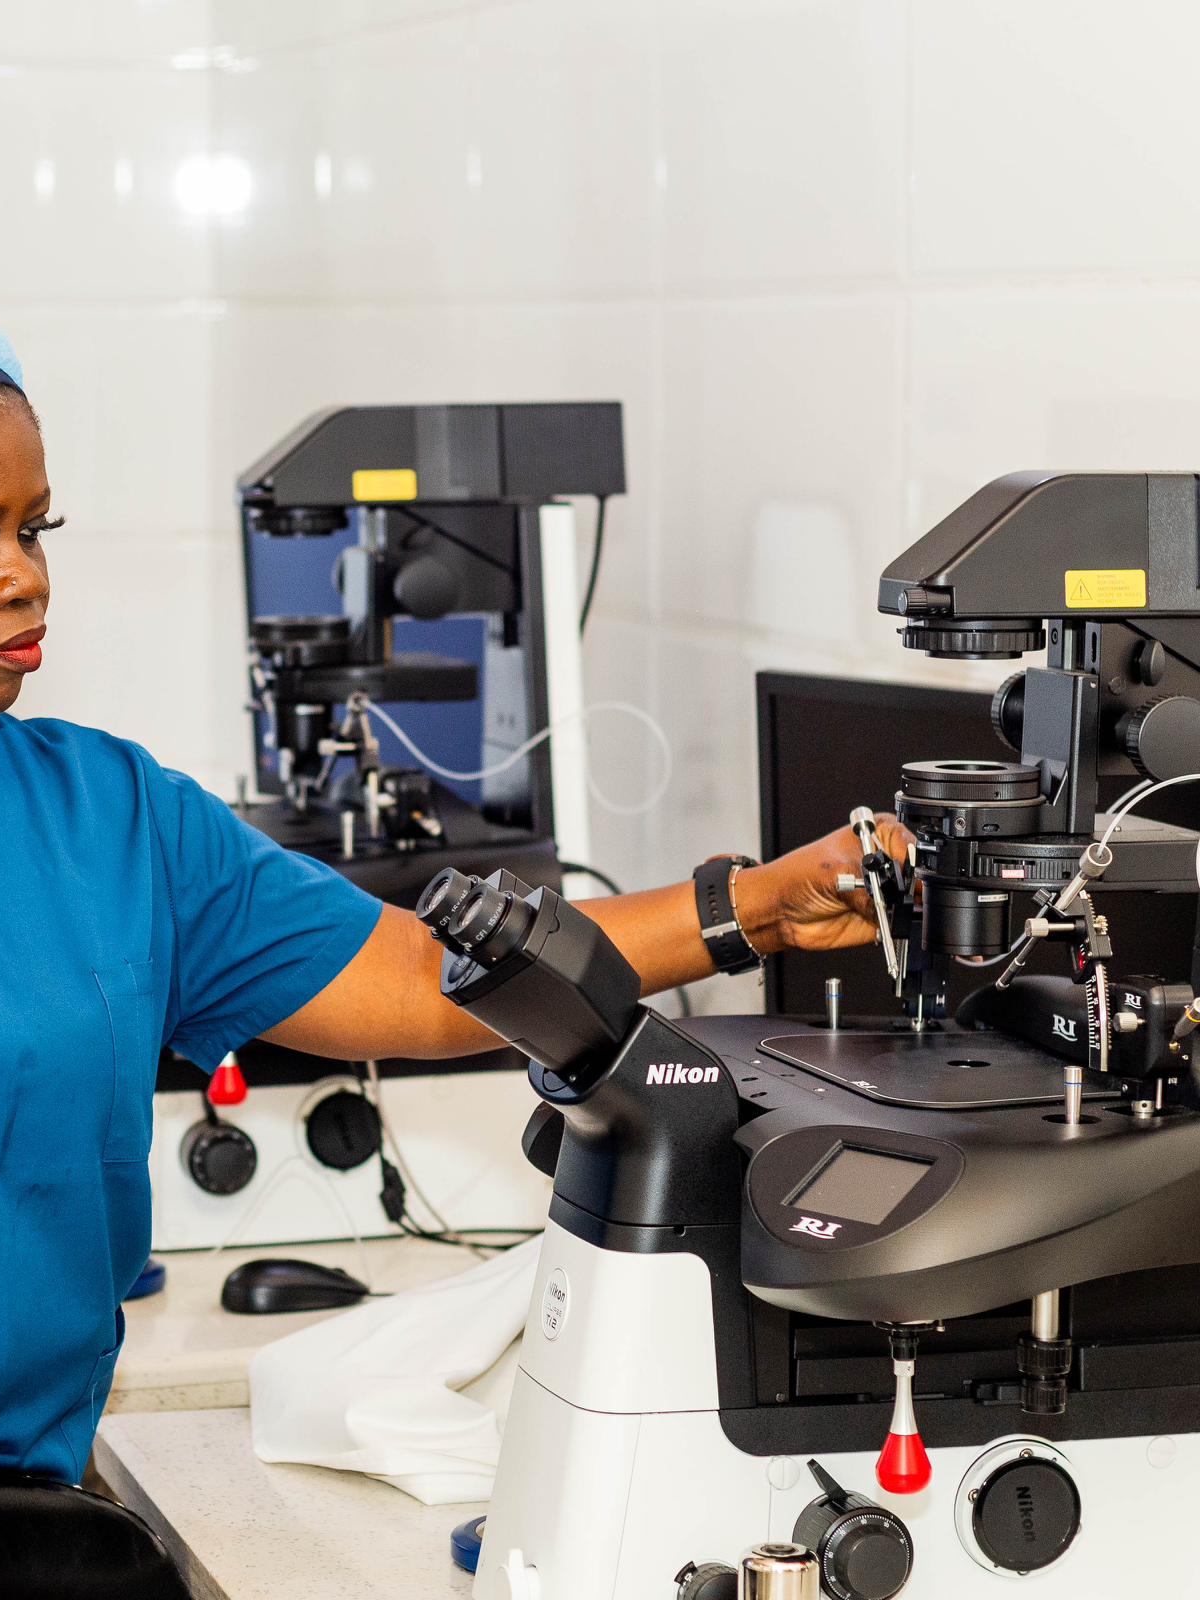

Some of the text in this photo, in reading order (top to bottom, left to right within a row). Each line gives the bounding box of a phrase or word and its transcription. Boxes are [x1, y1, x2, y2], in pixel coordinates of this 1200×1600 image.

[439, 915, 451, 927] CFI
[475, 929, 488, 942] CFI
[1125, 993, 1142, 1007] RI
[1053, 1014, 1077, 1039] RI
[645, 1063, 720, 1085] Nikon
[791, 1216, 842, 1237] RI
[1016, 1486, 1036, 1543] Nikon
